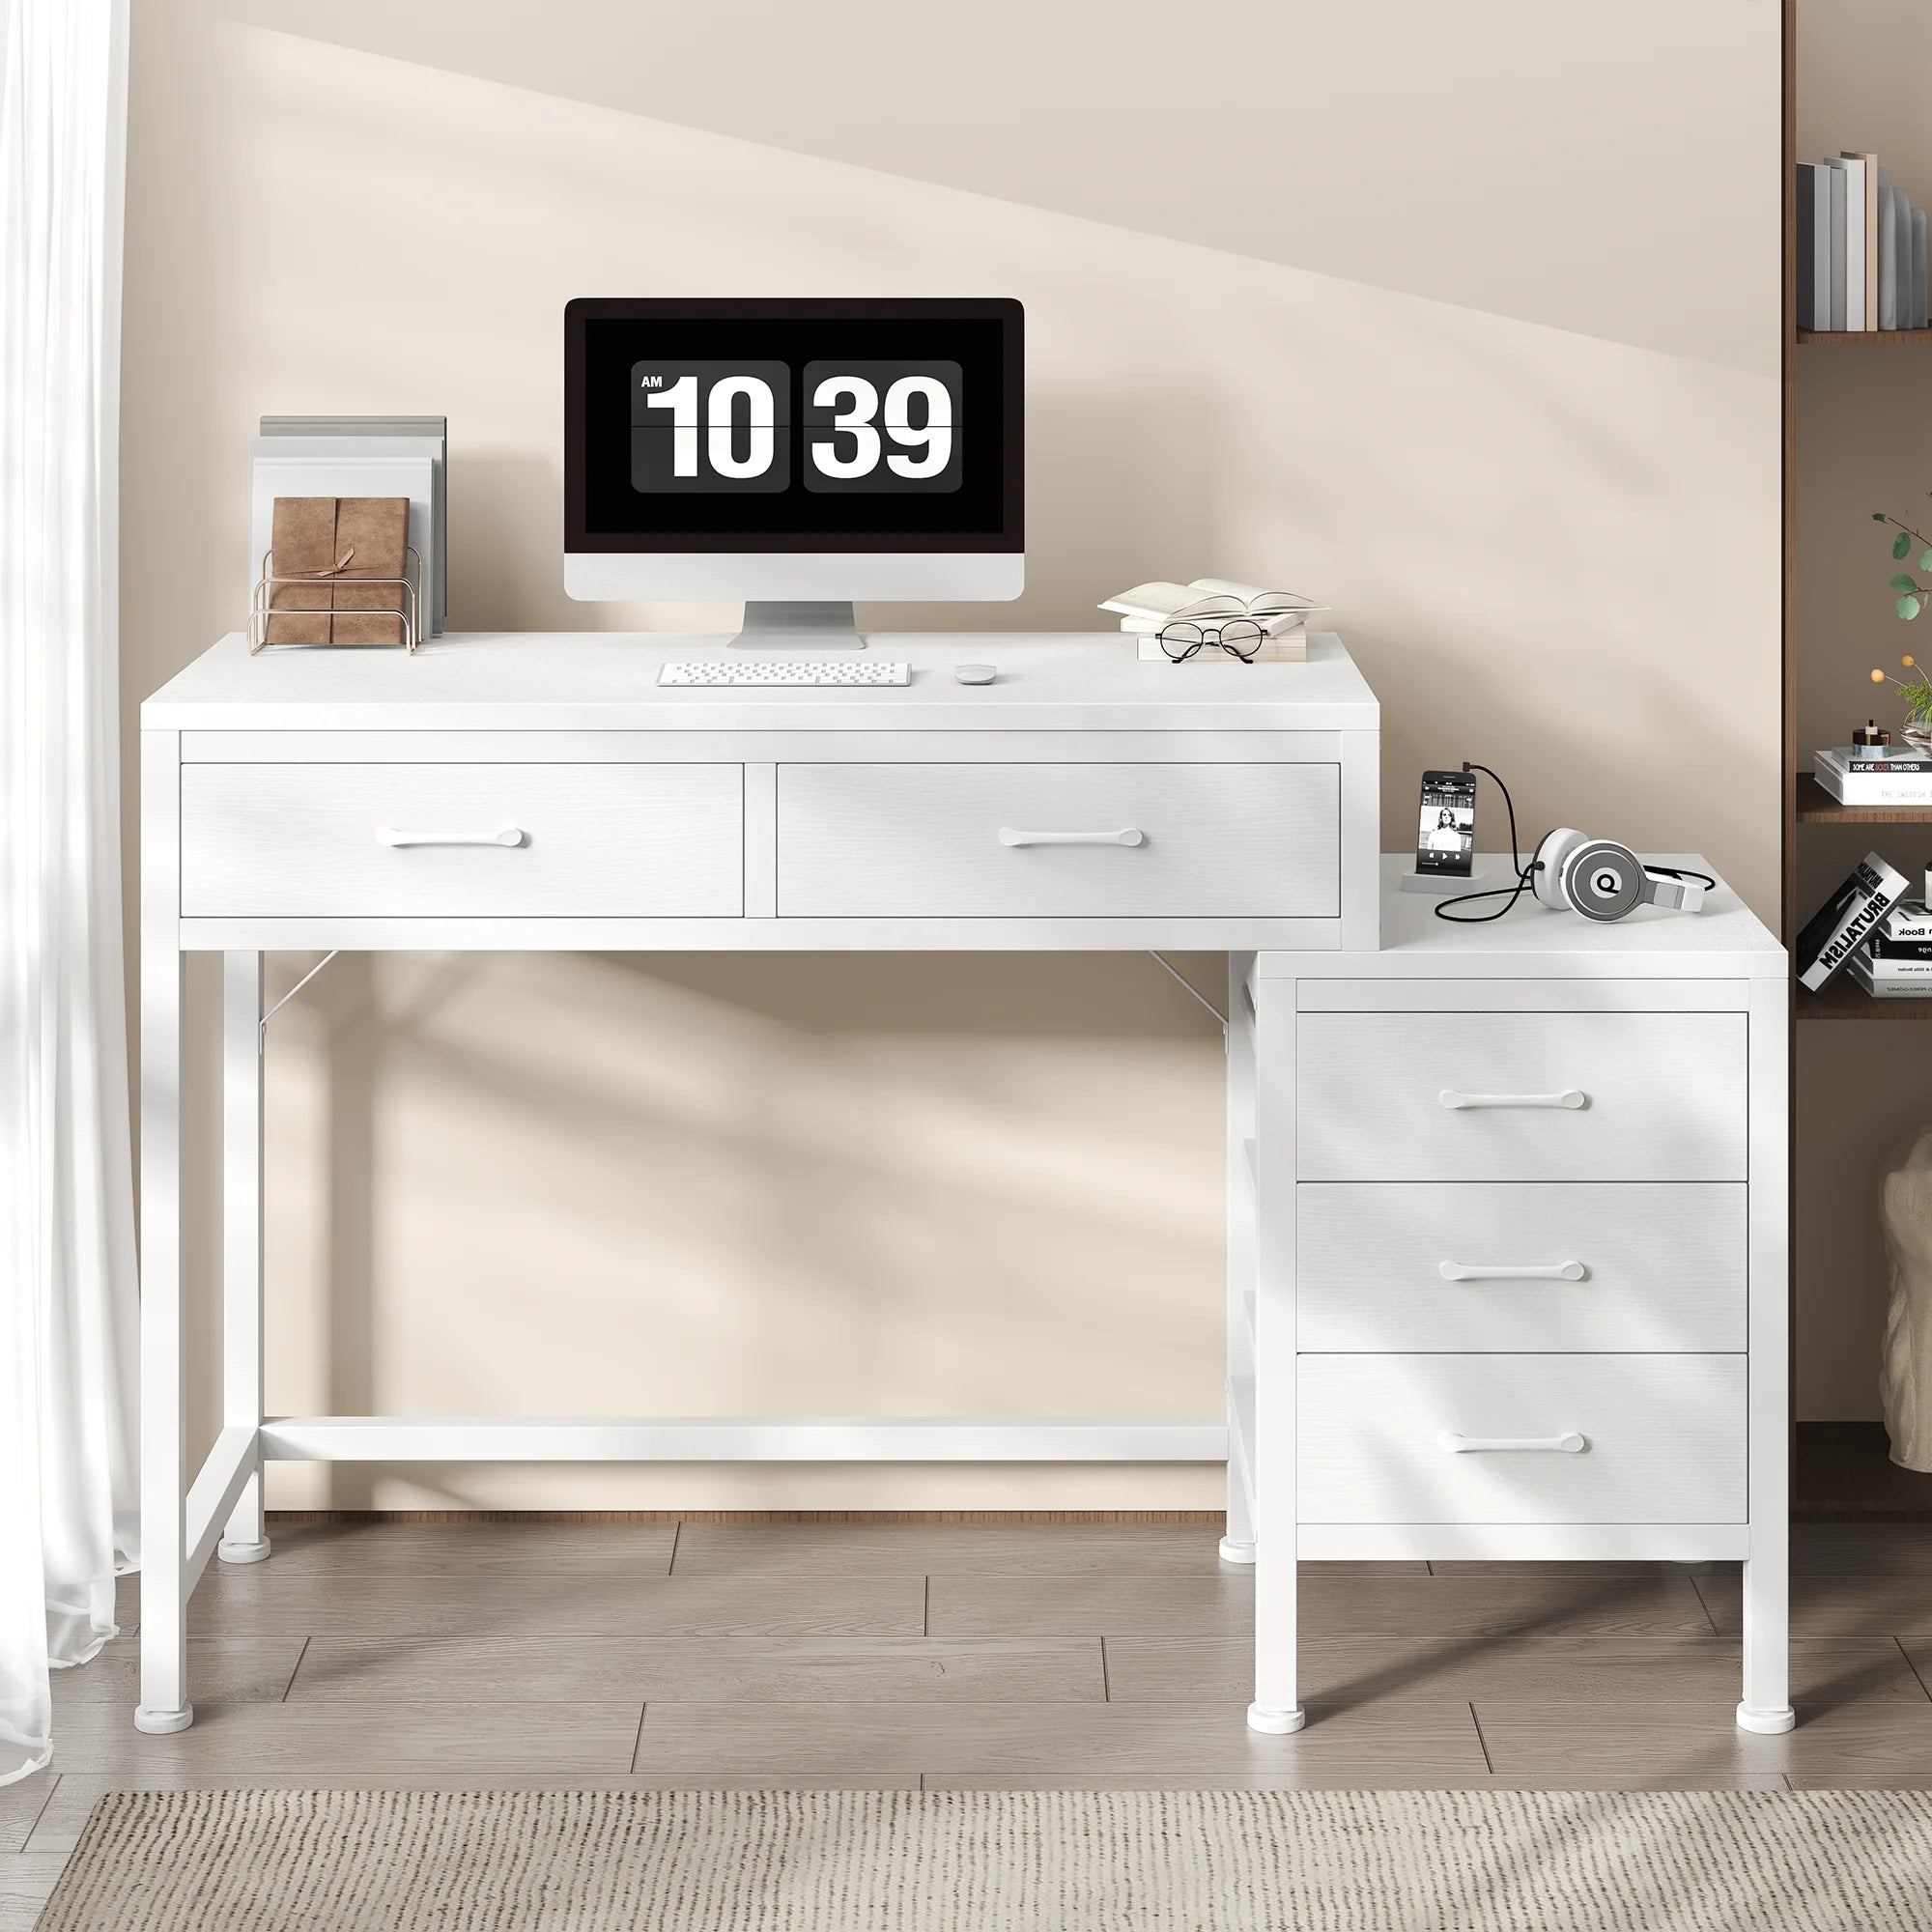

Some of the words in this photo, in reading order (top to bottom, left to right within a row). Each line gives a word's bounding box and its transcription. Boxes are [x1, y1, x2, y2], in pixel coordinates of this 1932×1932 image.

[640, 376, 663, 387] AM
[646, 375, 775, 479] 10
[811, 375, 952, 479] 39
